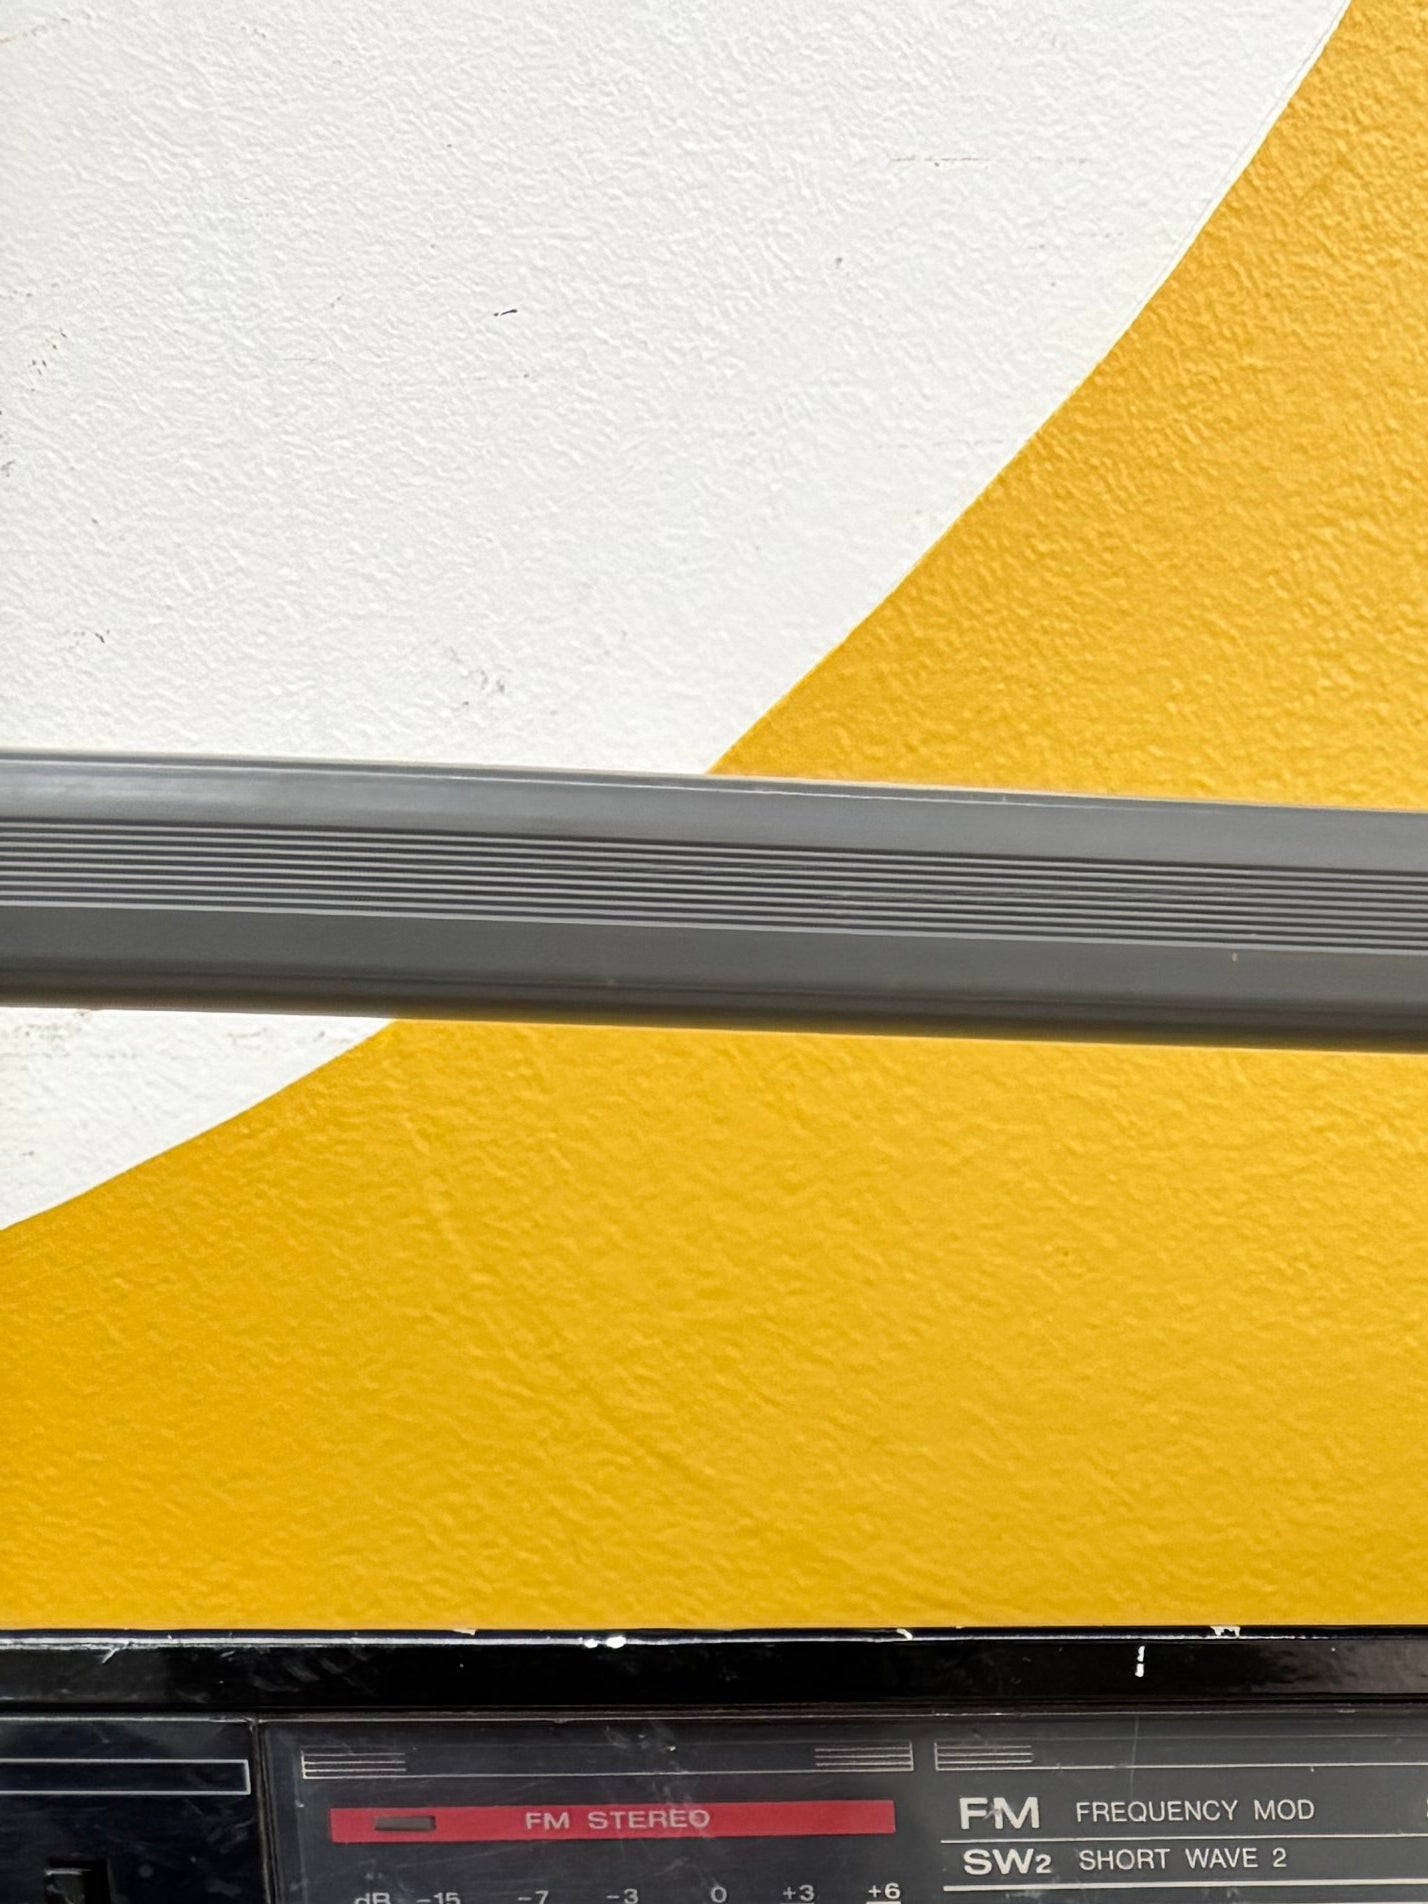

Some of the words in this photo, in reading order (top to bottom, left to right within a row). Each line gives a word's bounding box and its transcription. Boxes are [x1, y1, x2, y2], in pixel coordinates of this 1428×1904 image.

[524, 1811, 571, 1832] FM
[587, 1809, 712, 1831] STEREO
[958, 1796, 1041, 1831] FM
[1075, 1799, 1239, 1824] FREQUENCY
[1254, 1798, 1316, 1822] MOD
[962, 1848, 1053, 1876] SW2
[1078, 1848, 1171, 1872] SHORT
[1185, 1846, 1260, 1870] WAVE
[1272, 1847, 1288, 1870] 2
[709, 1884, 728, 1904] 0
[781, 1883, 815, 1904] +3
[868, 1882, 901, 1900] +6
